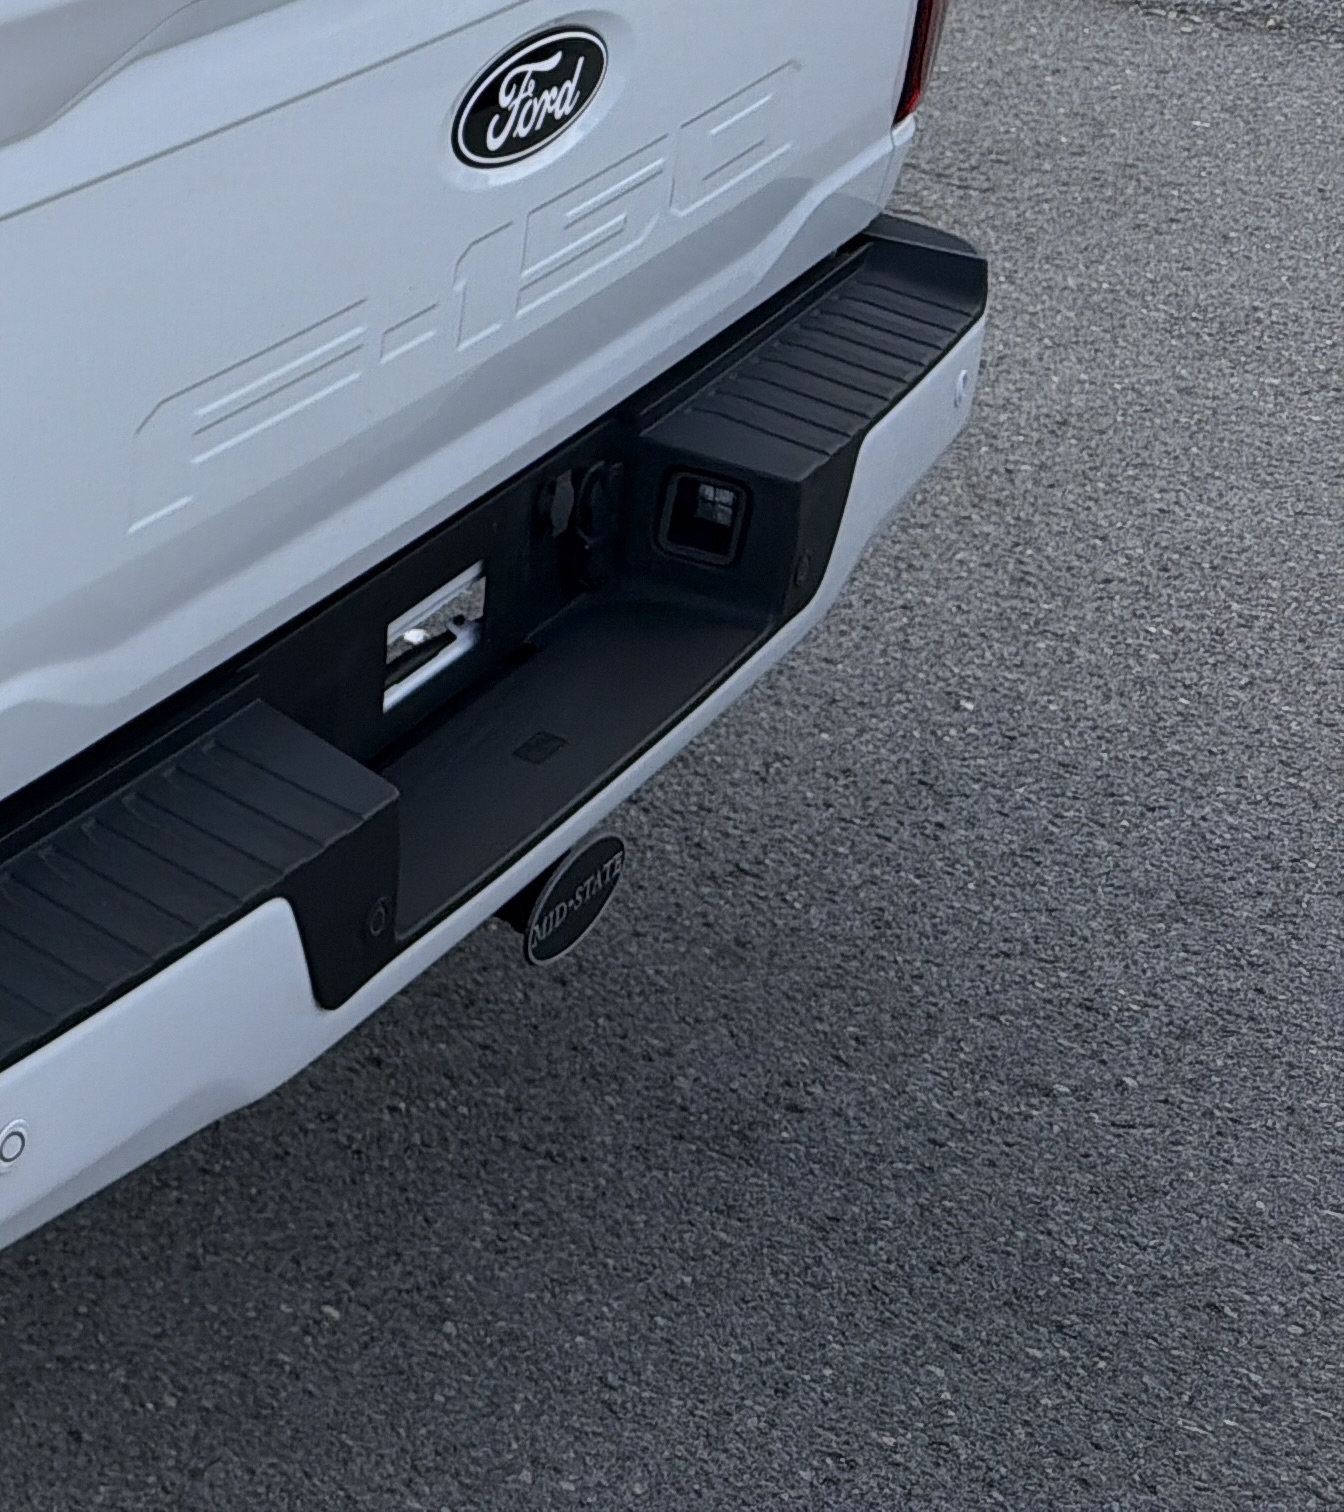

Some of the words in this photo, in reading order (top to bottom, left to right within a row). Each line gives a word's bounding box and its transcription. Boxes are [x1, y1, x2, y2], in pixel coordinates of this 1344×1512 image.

[486, 50, 585, 152] Ford
[126, 57, 803, 535] F-150
[532, 850, 624, 949] MID-STATE
